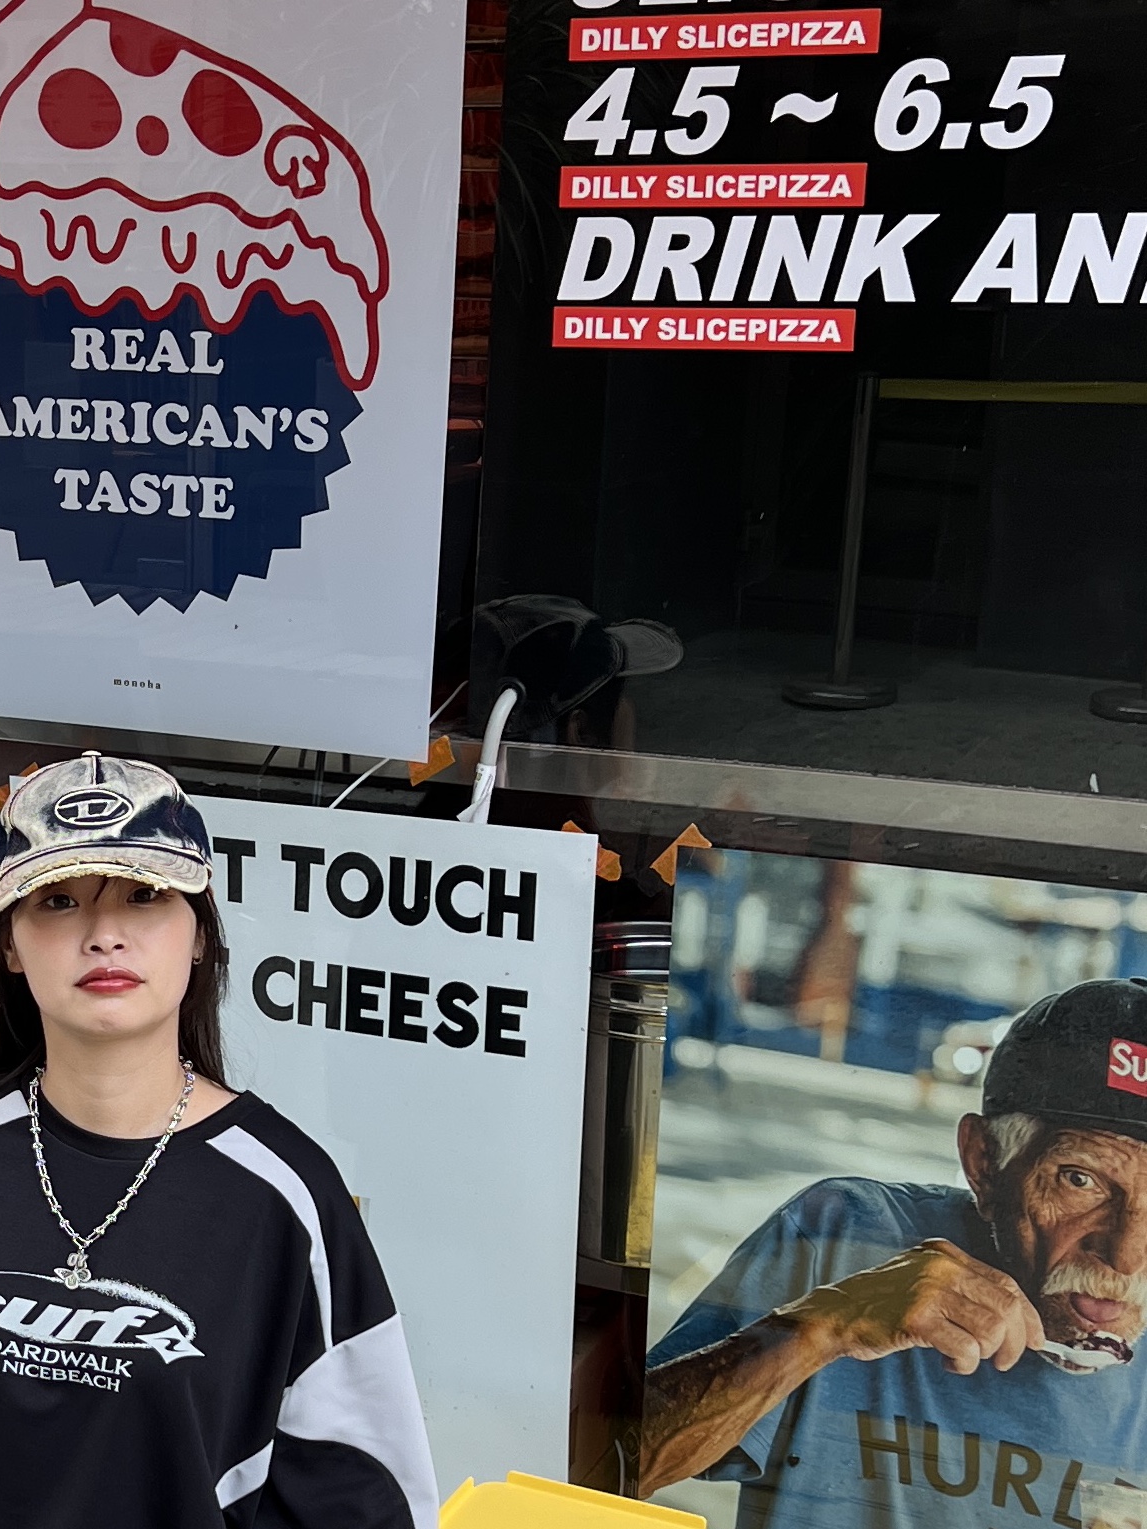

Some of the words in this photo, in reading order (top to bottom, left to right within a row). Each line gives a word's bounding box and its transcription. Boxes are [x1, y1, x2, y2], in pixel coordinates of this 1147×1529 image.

[581, 25, 668, 52] DILLY
[677, 21, 866, 49] SLICEPIZZA
[563, 65, 741, 156] 4.5
[873, 54, 1066, 152] 6.5
[571, 175, 657, 200] DILLY
[666, 173, 852, 200] SLICEPIZZA
[557, 213, 940, 303] DRINK
[951, 212, 1147, 304] AN
[71, 327, 224, 375] REAL
[564, 318, 649, 340] DILLY
[657, 318, 841, 343] SLICEPIZZA
[53, 468, 234, 520] TASTE
[280, 843, 538, 942] TOUCH
[252, 955, 529, 1058] CHEESE
[2, 1359, 121, 1393] NICEBEACH
